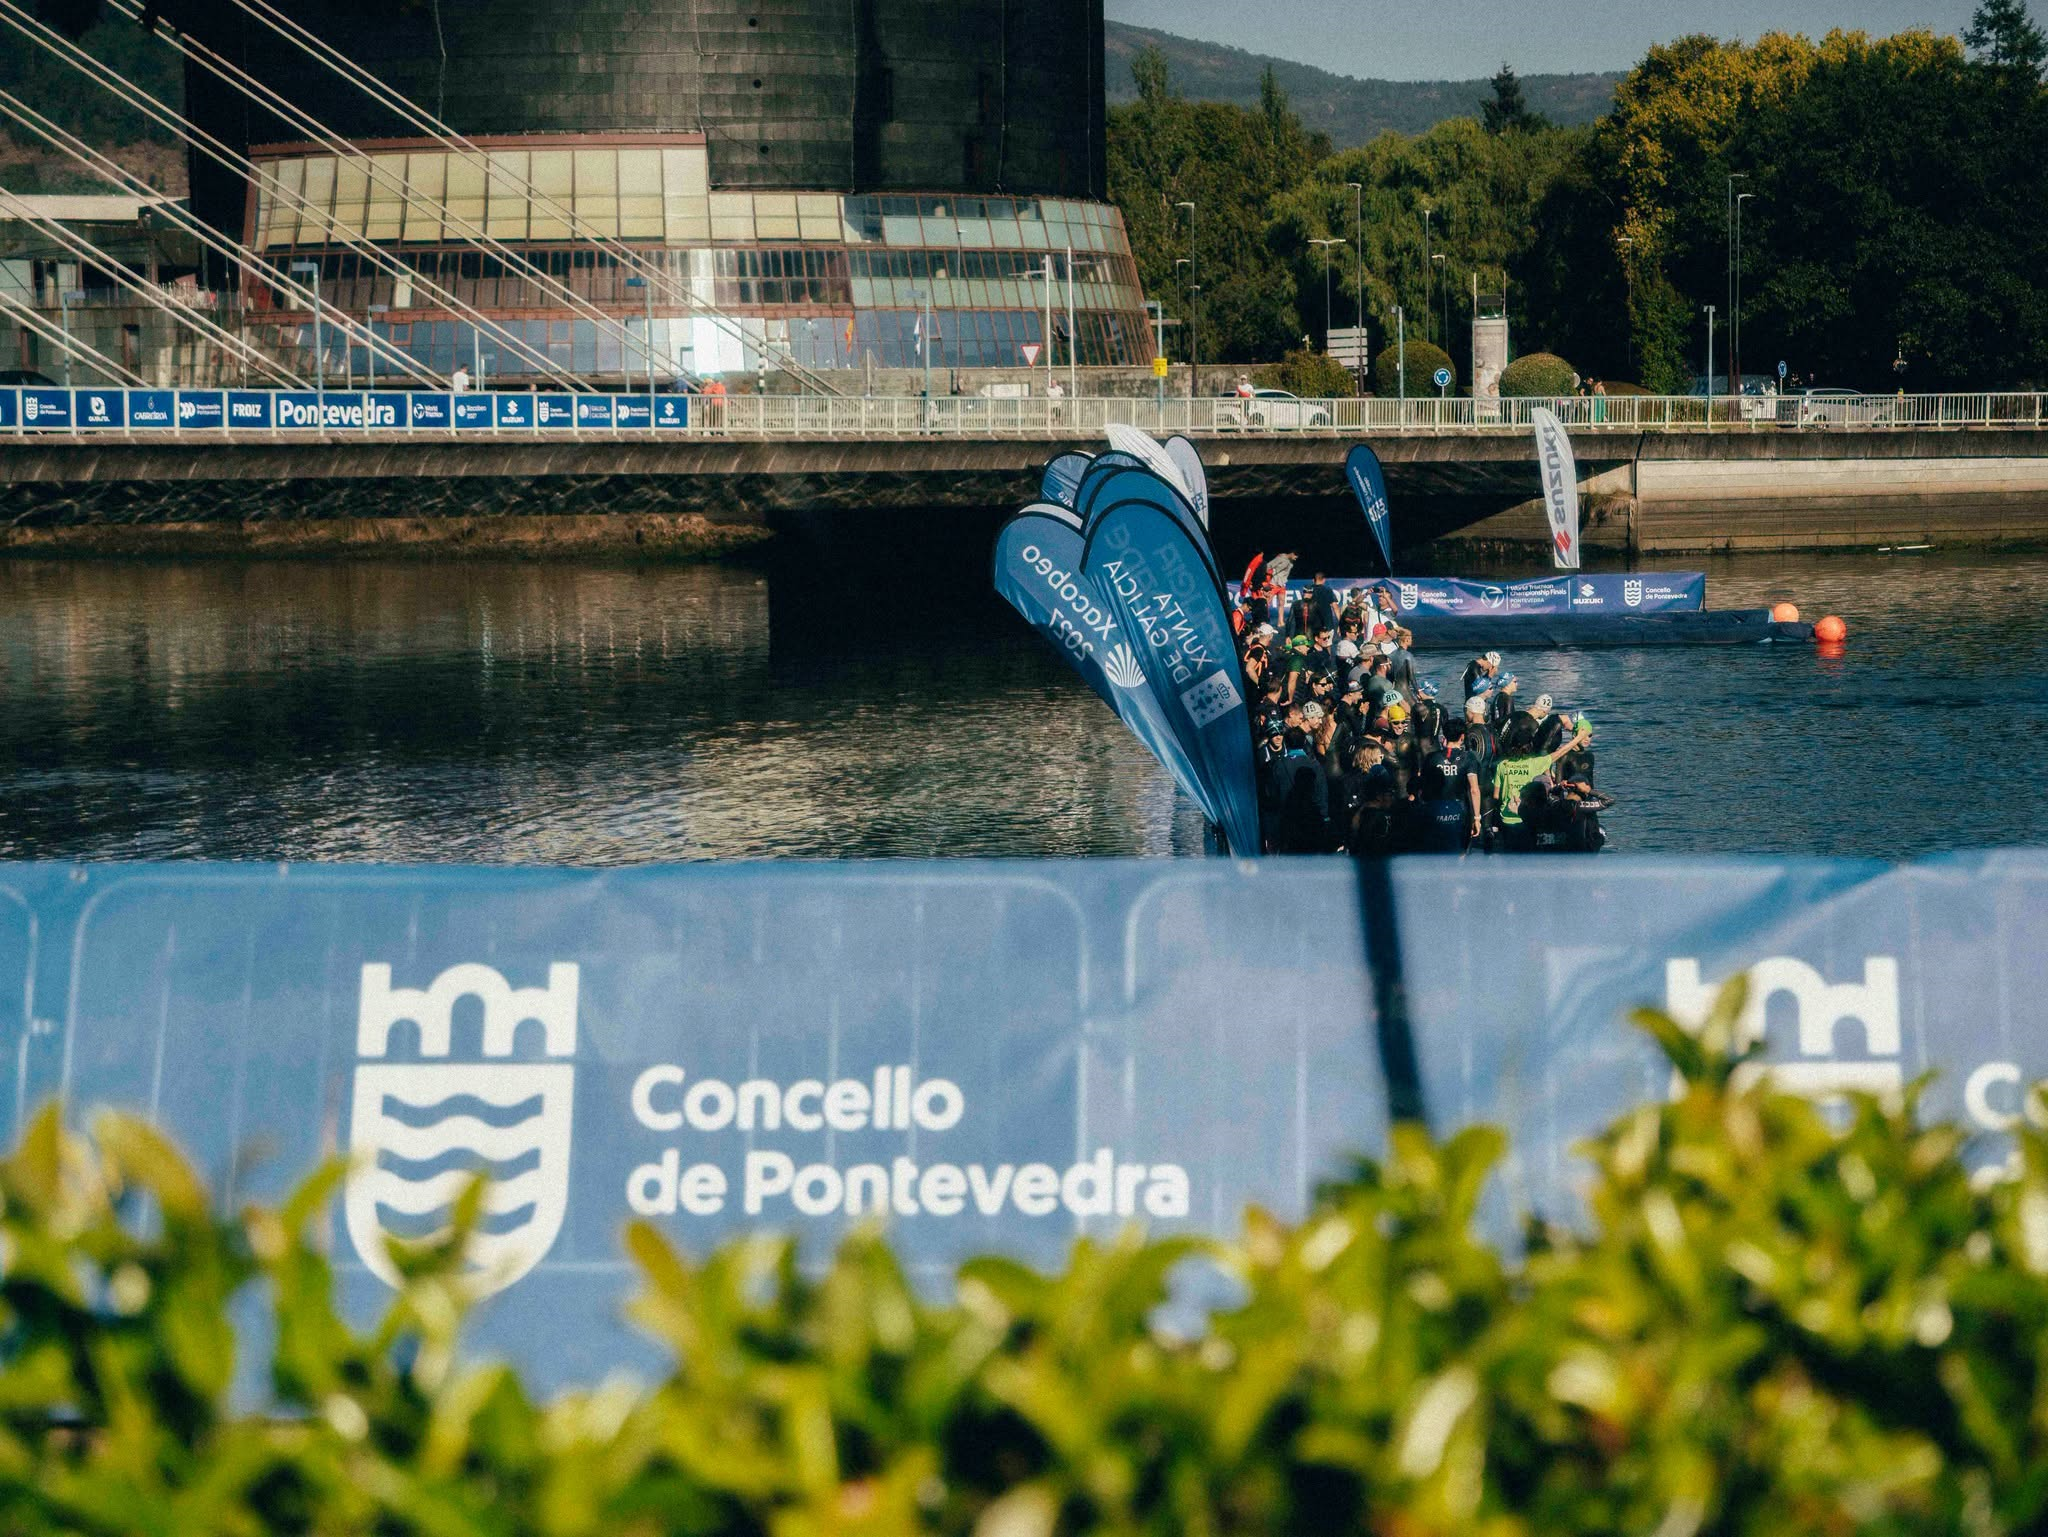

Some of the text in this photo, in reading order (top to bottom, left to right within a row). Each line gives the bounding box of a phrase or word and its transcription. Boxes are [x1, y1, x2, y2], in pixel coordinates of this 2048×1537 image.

[233, 403, 261, 417] FROIZ
[1385, 694, 1398, 703] 80
[630, 1064, 966, 1132] Concello
[625, 1148, 1191, 1218] de Pontevedra
